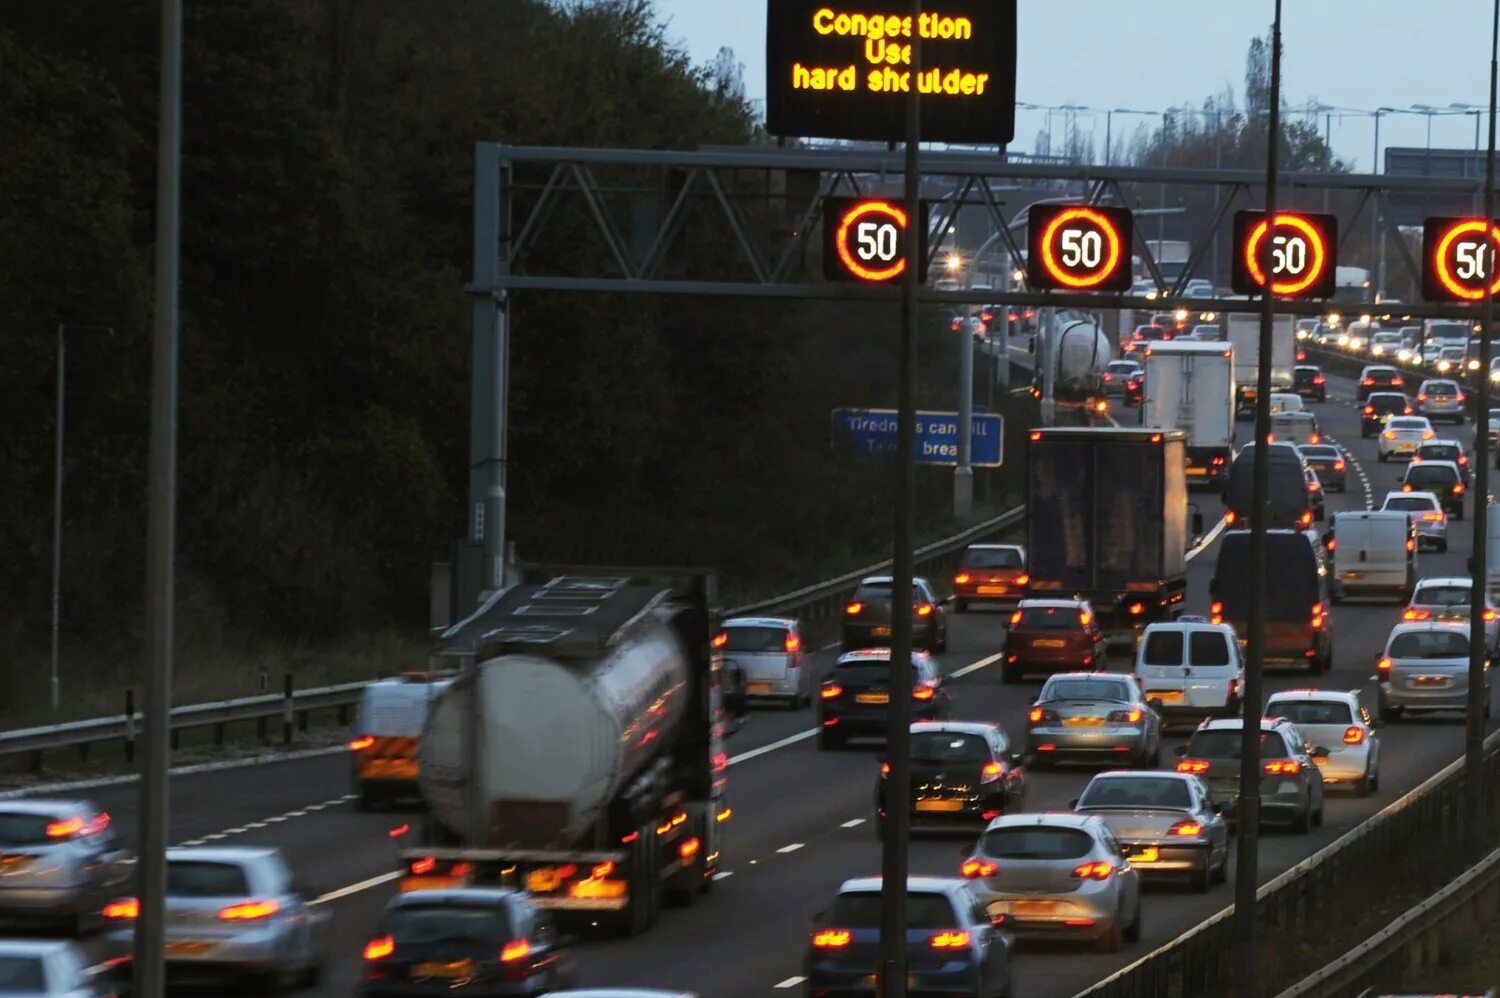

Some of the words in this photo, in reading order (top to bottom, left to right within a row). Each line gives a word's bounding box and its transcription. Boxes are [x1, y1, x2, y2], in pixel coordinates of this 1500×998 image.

[813, 8, 972, 39] Congestion
[793, 63, 856, 90] hard
[857, 222, 897, 261] 50
[1061, 229, 1101, 268] 50
[1271, 236, 1306, 274] 50
[849, 416, 923, 433] Tiredns
[928, 423, 957, 435] can
[923, 441, 959, 456] brea
